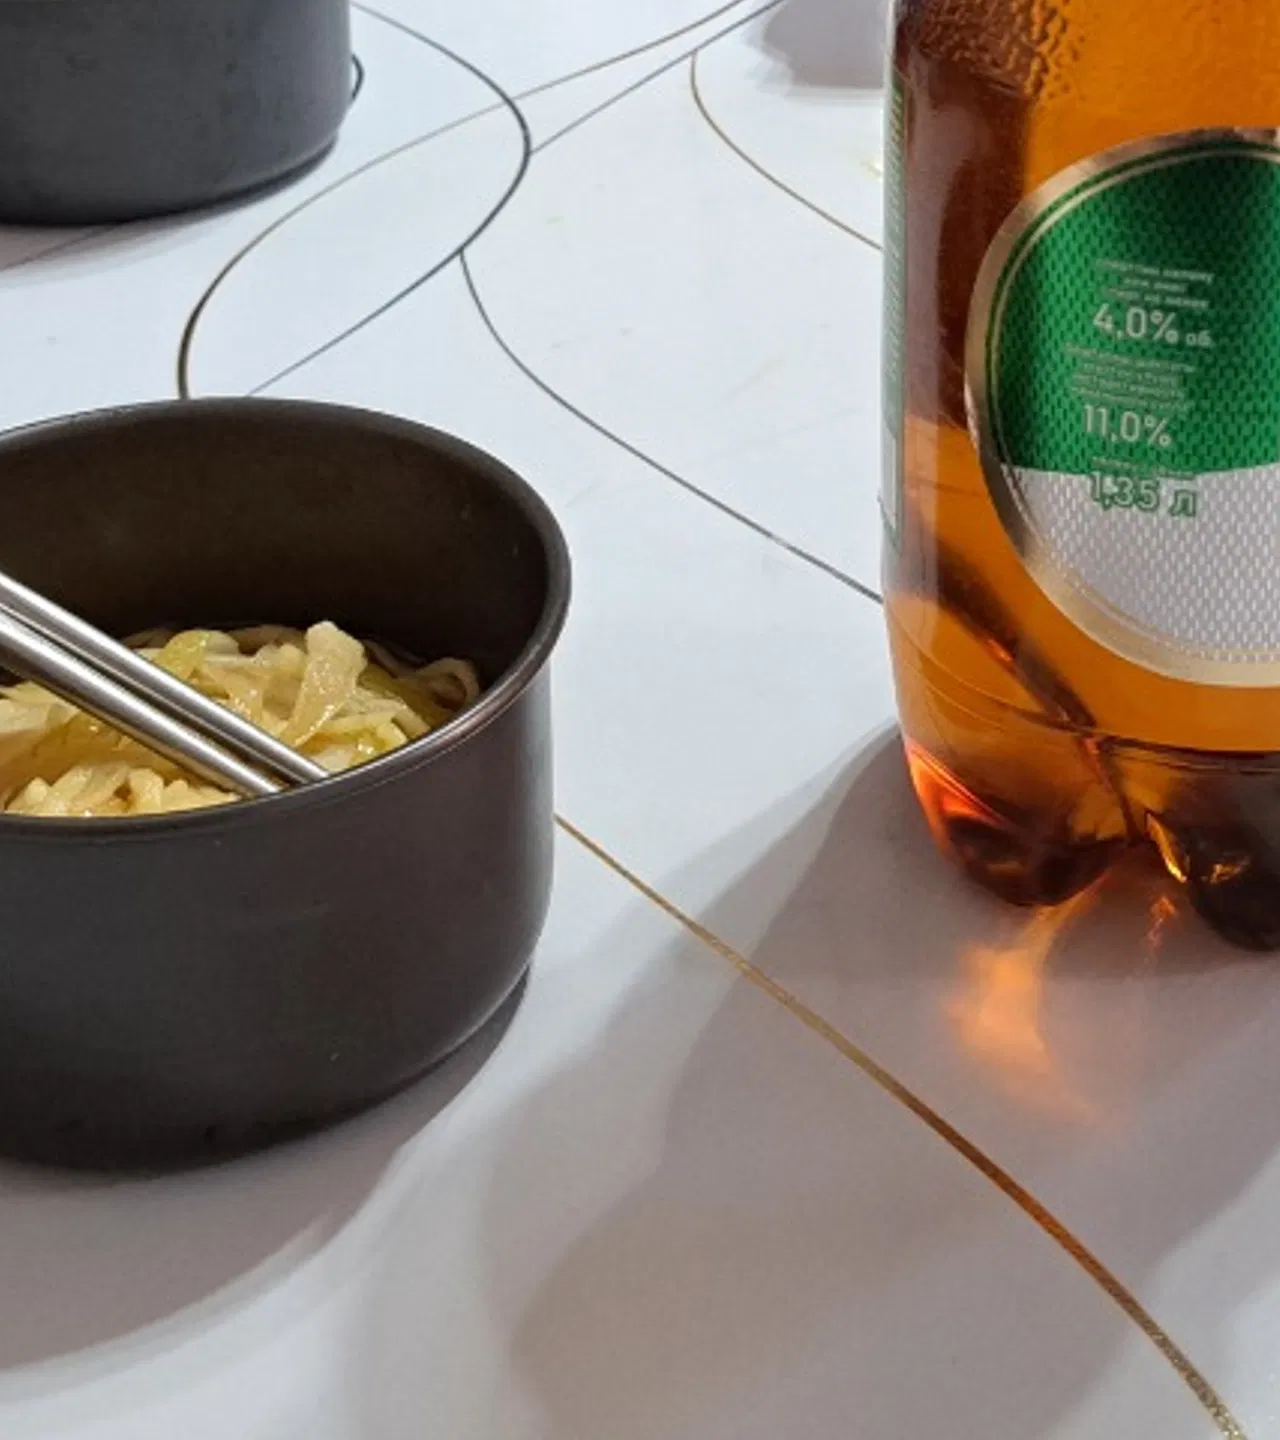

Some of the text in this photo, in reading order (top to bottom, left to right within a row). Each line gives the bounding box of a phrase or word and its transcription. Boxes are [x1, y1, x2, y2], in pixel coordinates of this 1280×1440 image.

[1092, 304, 1179, 346] 4,0%
[1084, 404, 1172, 448] 11,0%
[1089, 471, 1161, 512] 1,35
